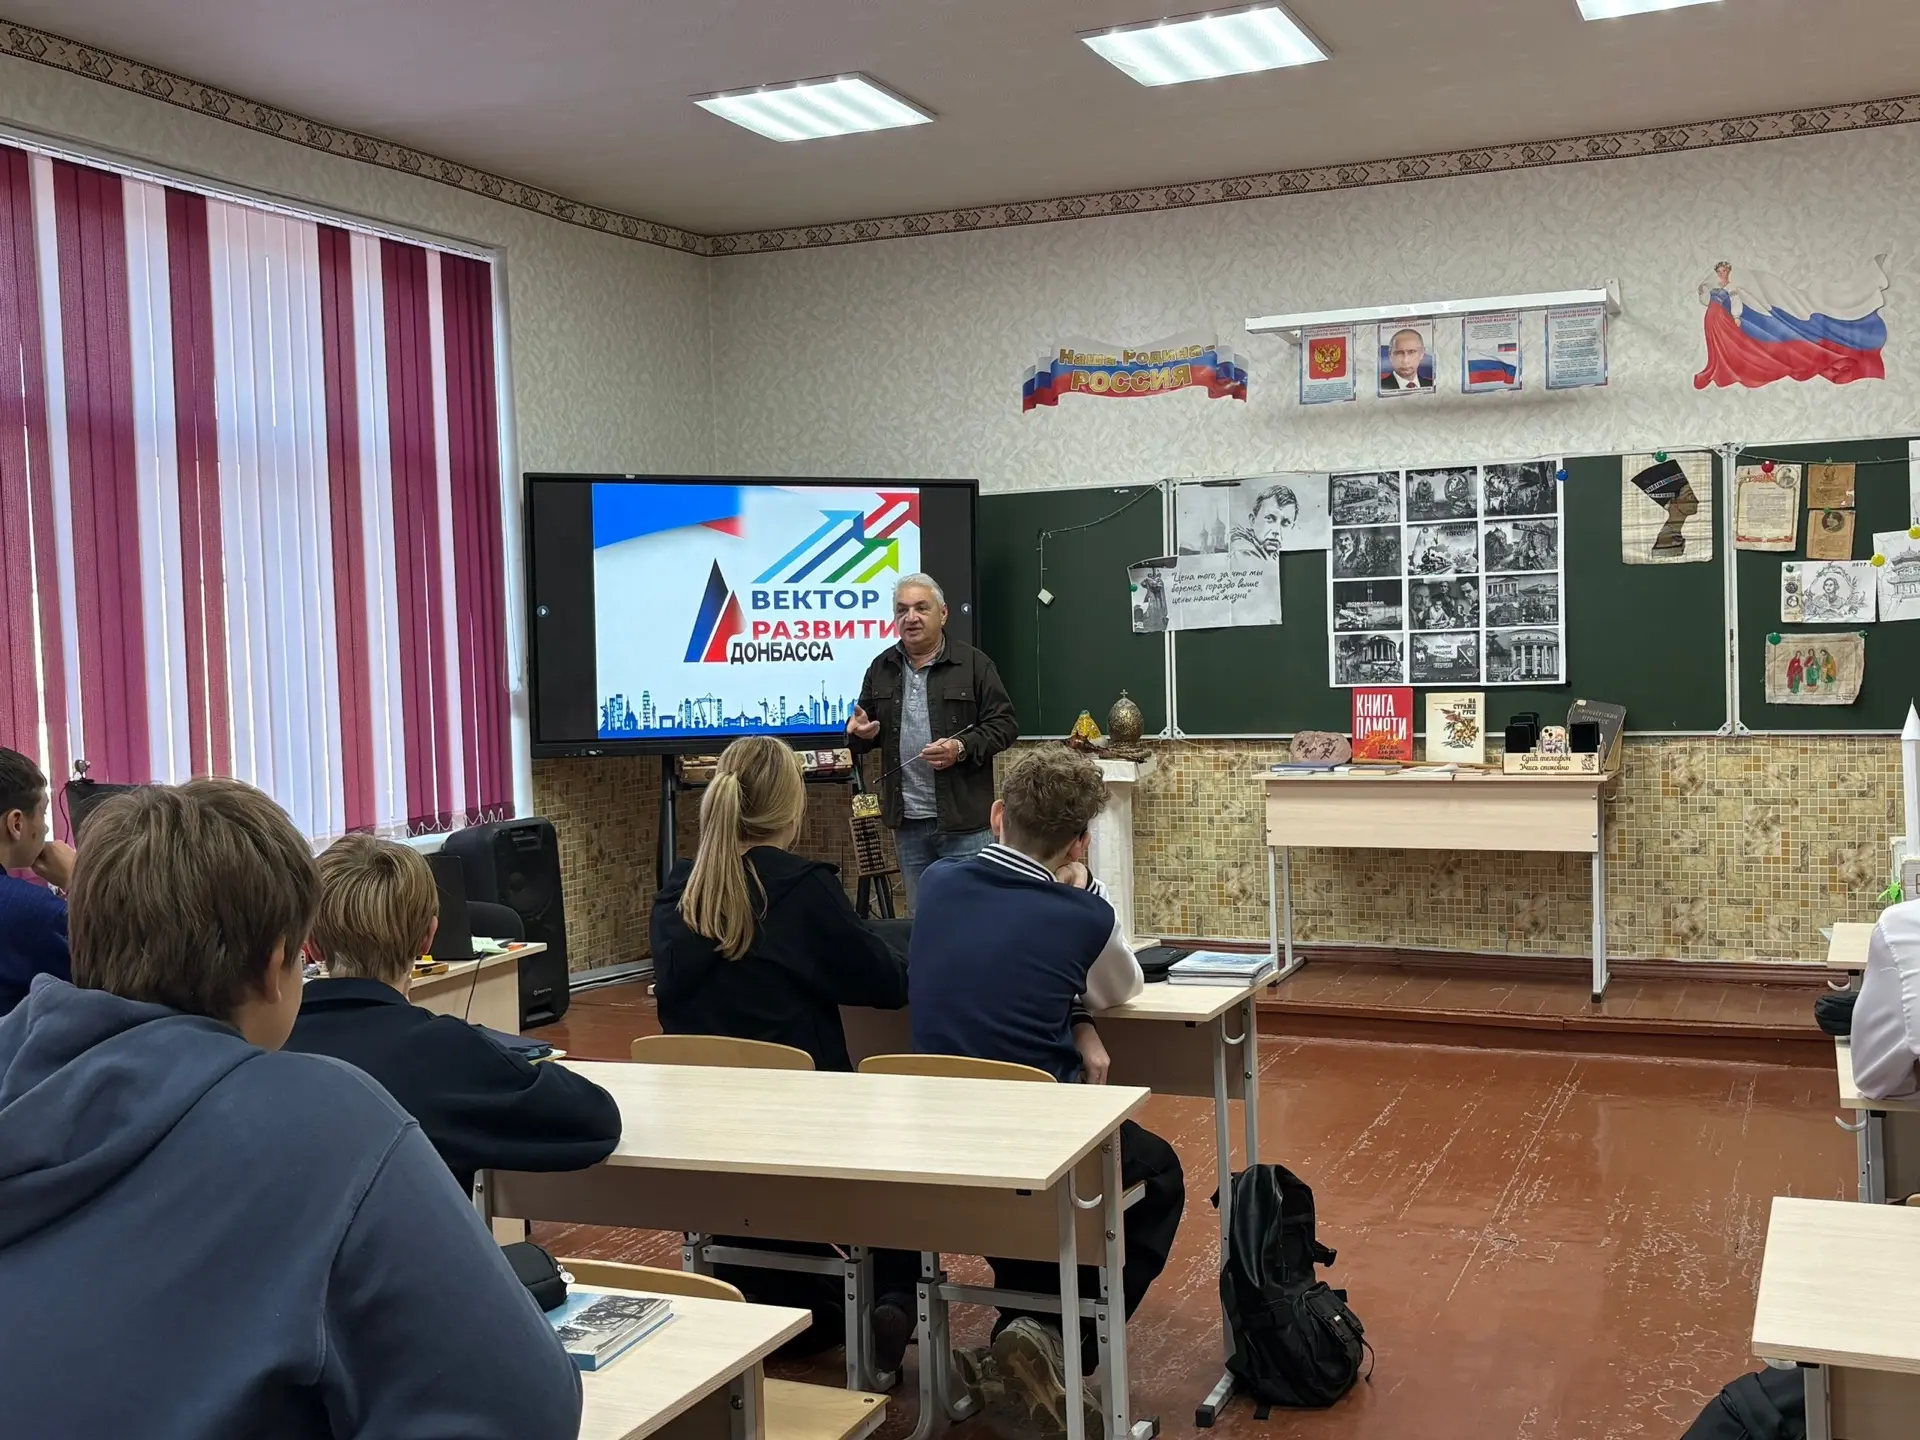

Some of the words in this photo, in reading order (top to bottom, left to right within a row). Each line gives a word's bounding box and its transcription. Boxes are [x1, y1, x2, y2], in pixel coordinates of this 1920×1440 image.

[1058, 348, 1117, 366] Наша
[1070, 363, 1193, 393] РОССИЯ
[1171, 583, 1203, 595] боремся,
[1205, 579, 1236, 594] гораздо
[1237, 577, 1260, 588] выше
[1197, 572, 1217, 580] того,
[1217, 571, 1229, 583] за
[752, 590, 879, 610] ВЕКТОР
[1193, 592, 1220, 603] нашей
[752, 619, 899, 641] РАЗВИТИ
[730, 641, 834, 665] ДОНБАССА
[1356, 694, 1395, 717] КНИГА
[1356, 717, 1407, 740] ПАМЯТИ
[1519, 763, 1539, 771] Учись
[1540, 763, 1570, 771] спокойно
[1540, 753, 1572, 764] телефон
